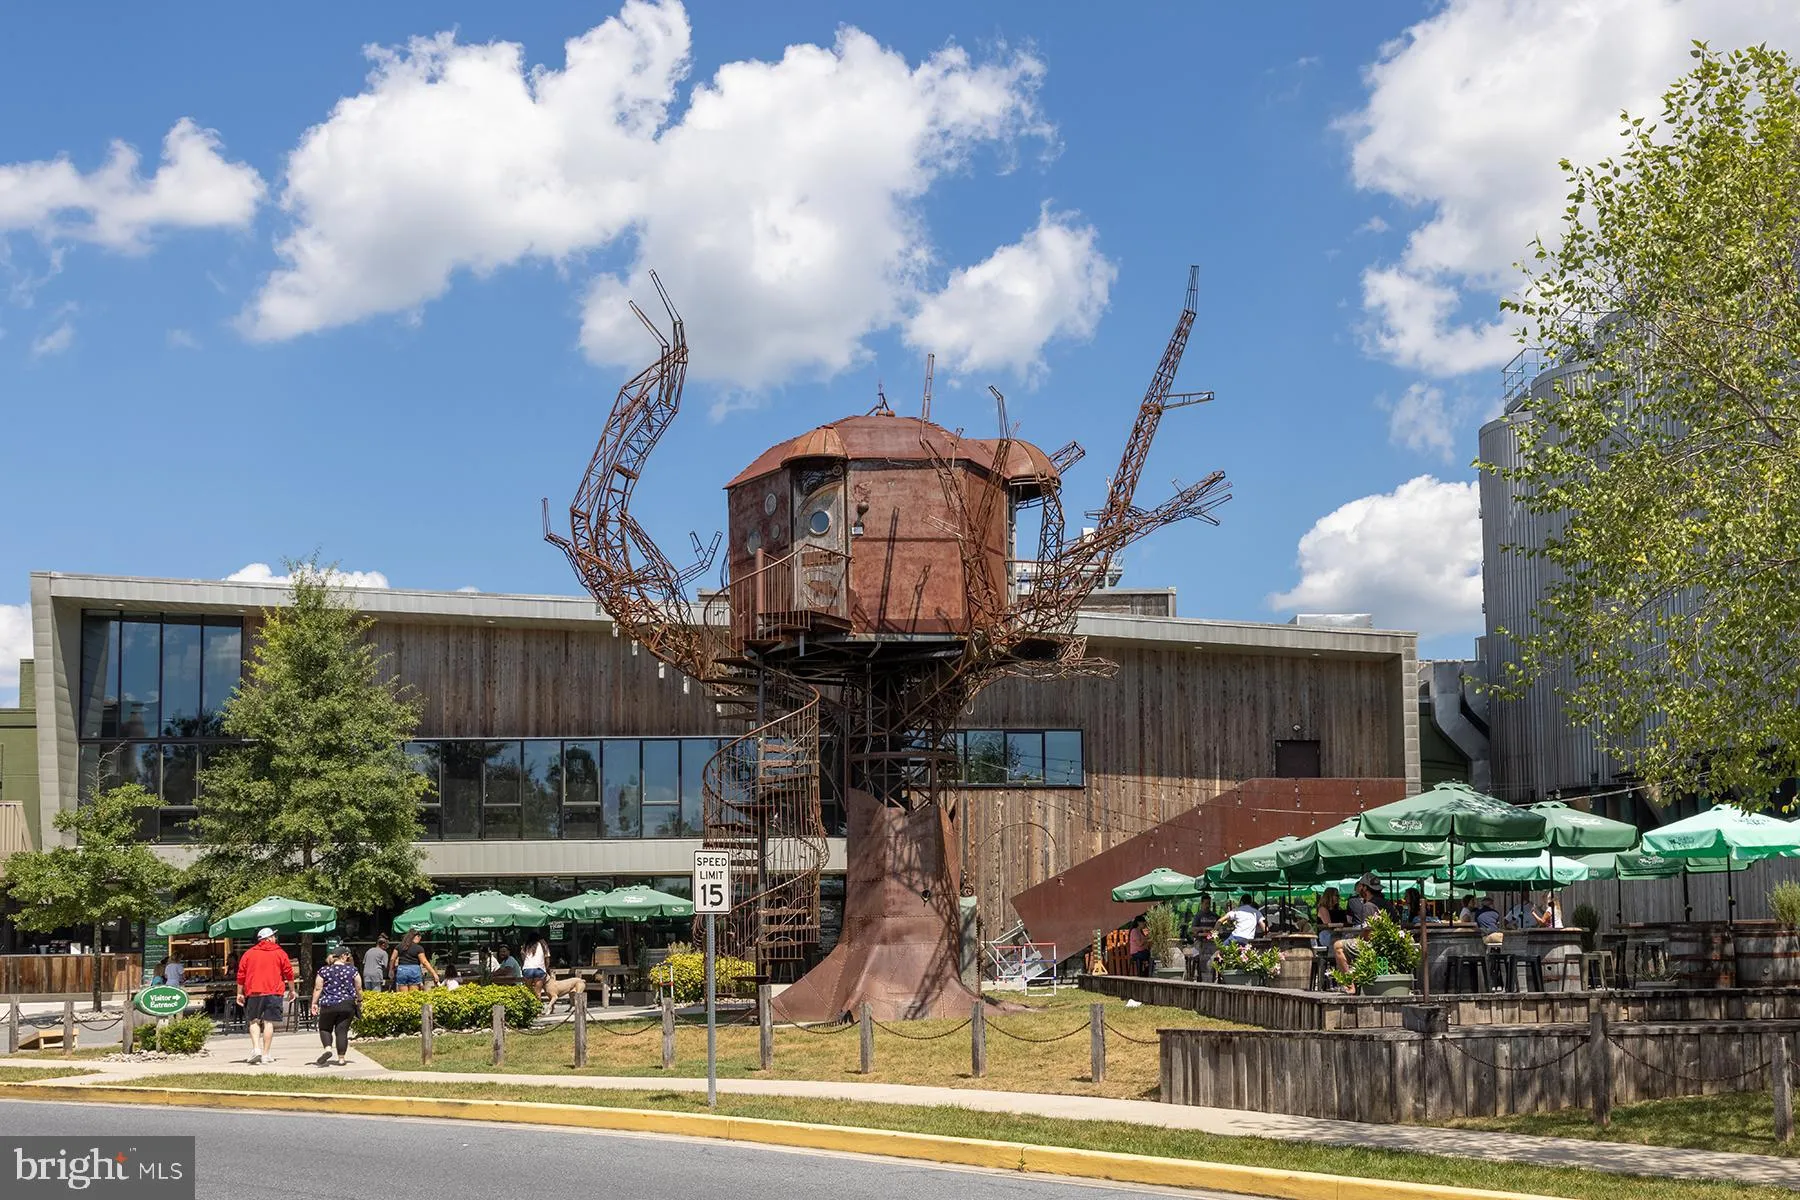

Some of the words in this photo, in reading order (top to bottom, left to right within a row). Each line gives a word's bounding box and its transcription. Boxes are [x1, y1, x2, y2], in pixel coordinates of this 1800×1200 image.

[697, 857, 727, 866] SPEED
[700, 871, 723, 880] LIMIT
[701, 883, 723, 907] 15
